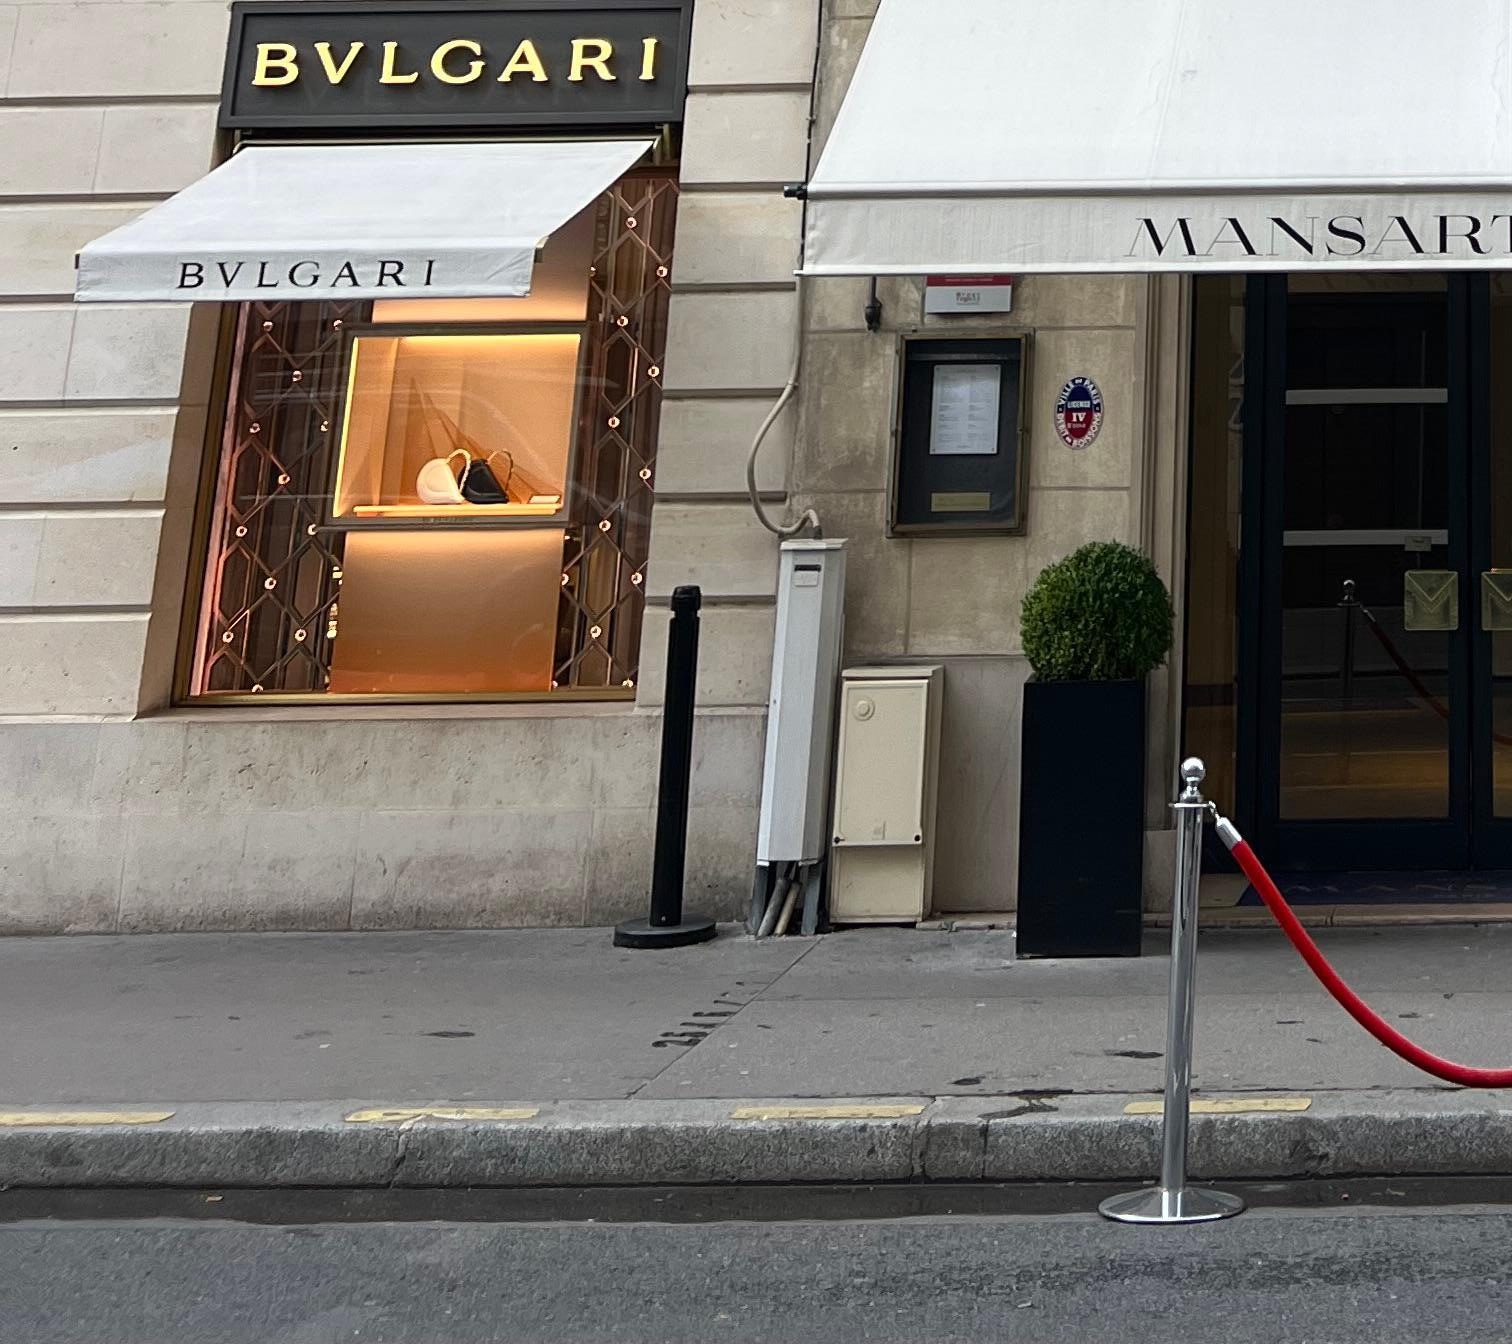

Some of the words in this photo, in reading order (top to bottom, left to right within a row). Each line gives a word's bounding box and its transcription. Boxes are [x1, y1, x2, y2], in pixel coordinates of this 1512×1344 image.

[250, 37, 659, 87] BVLGARI
[176, 258, 436, 290] BVLGARI
[1071, 412, 1087, 422] IV
